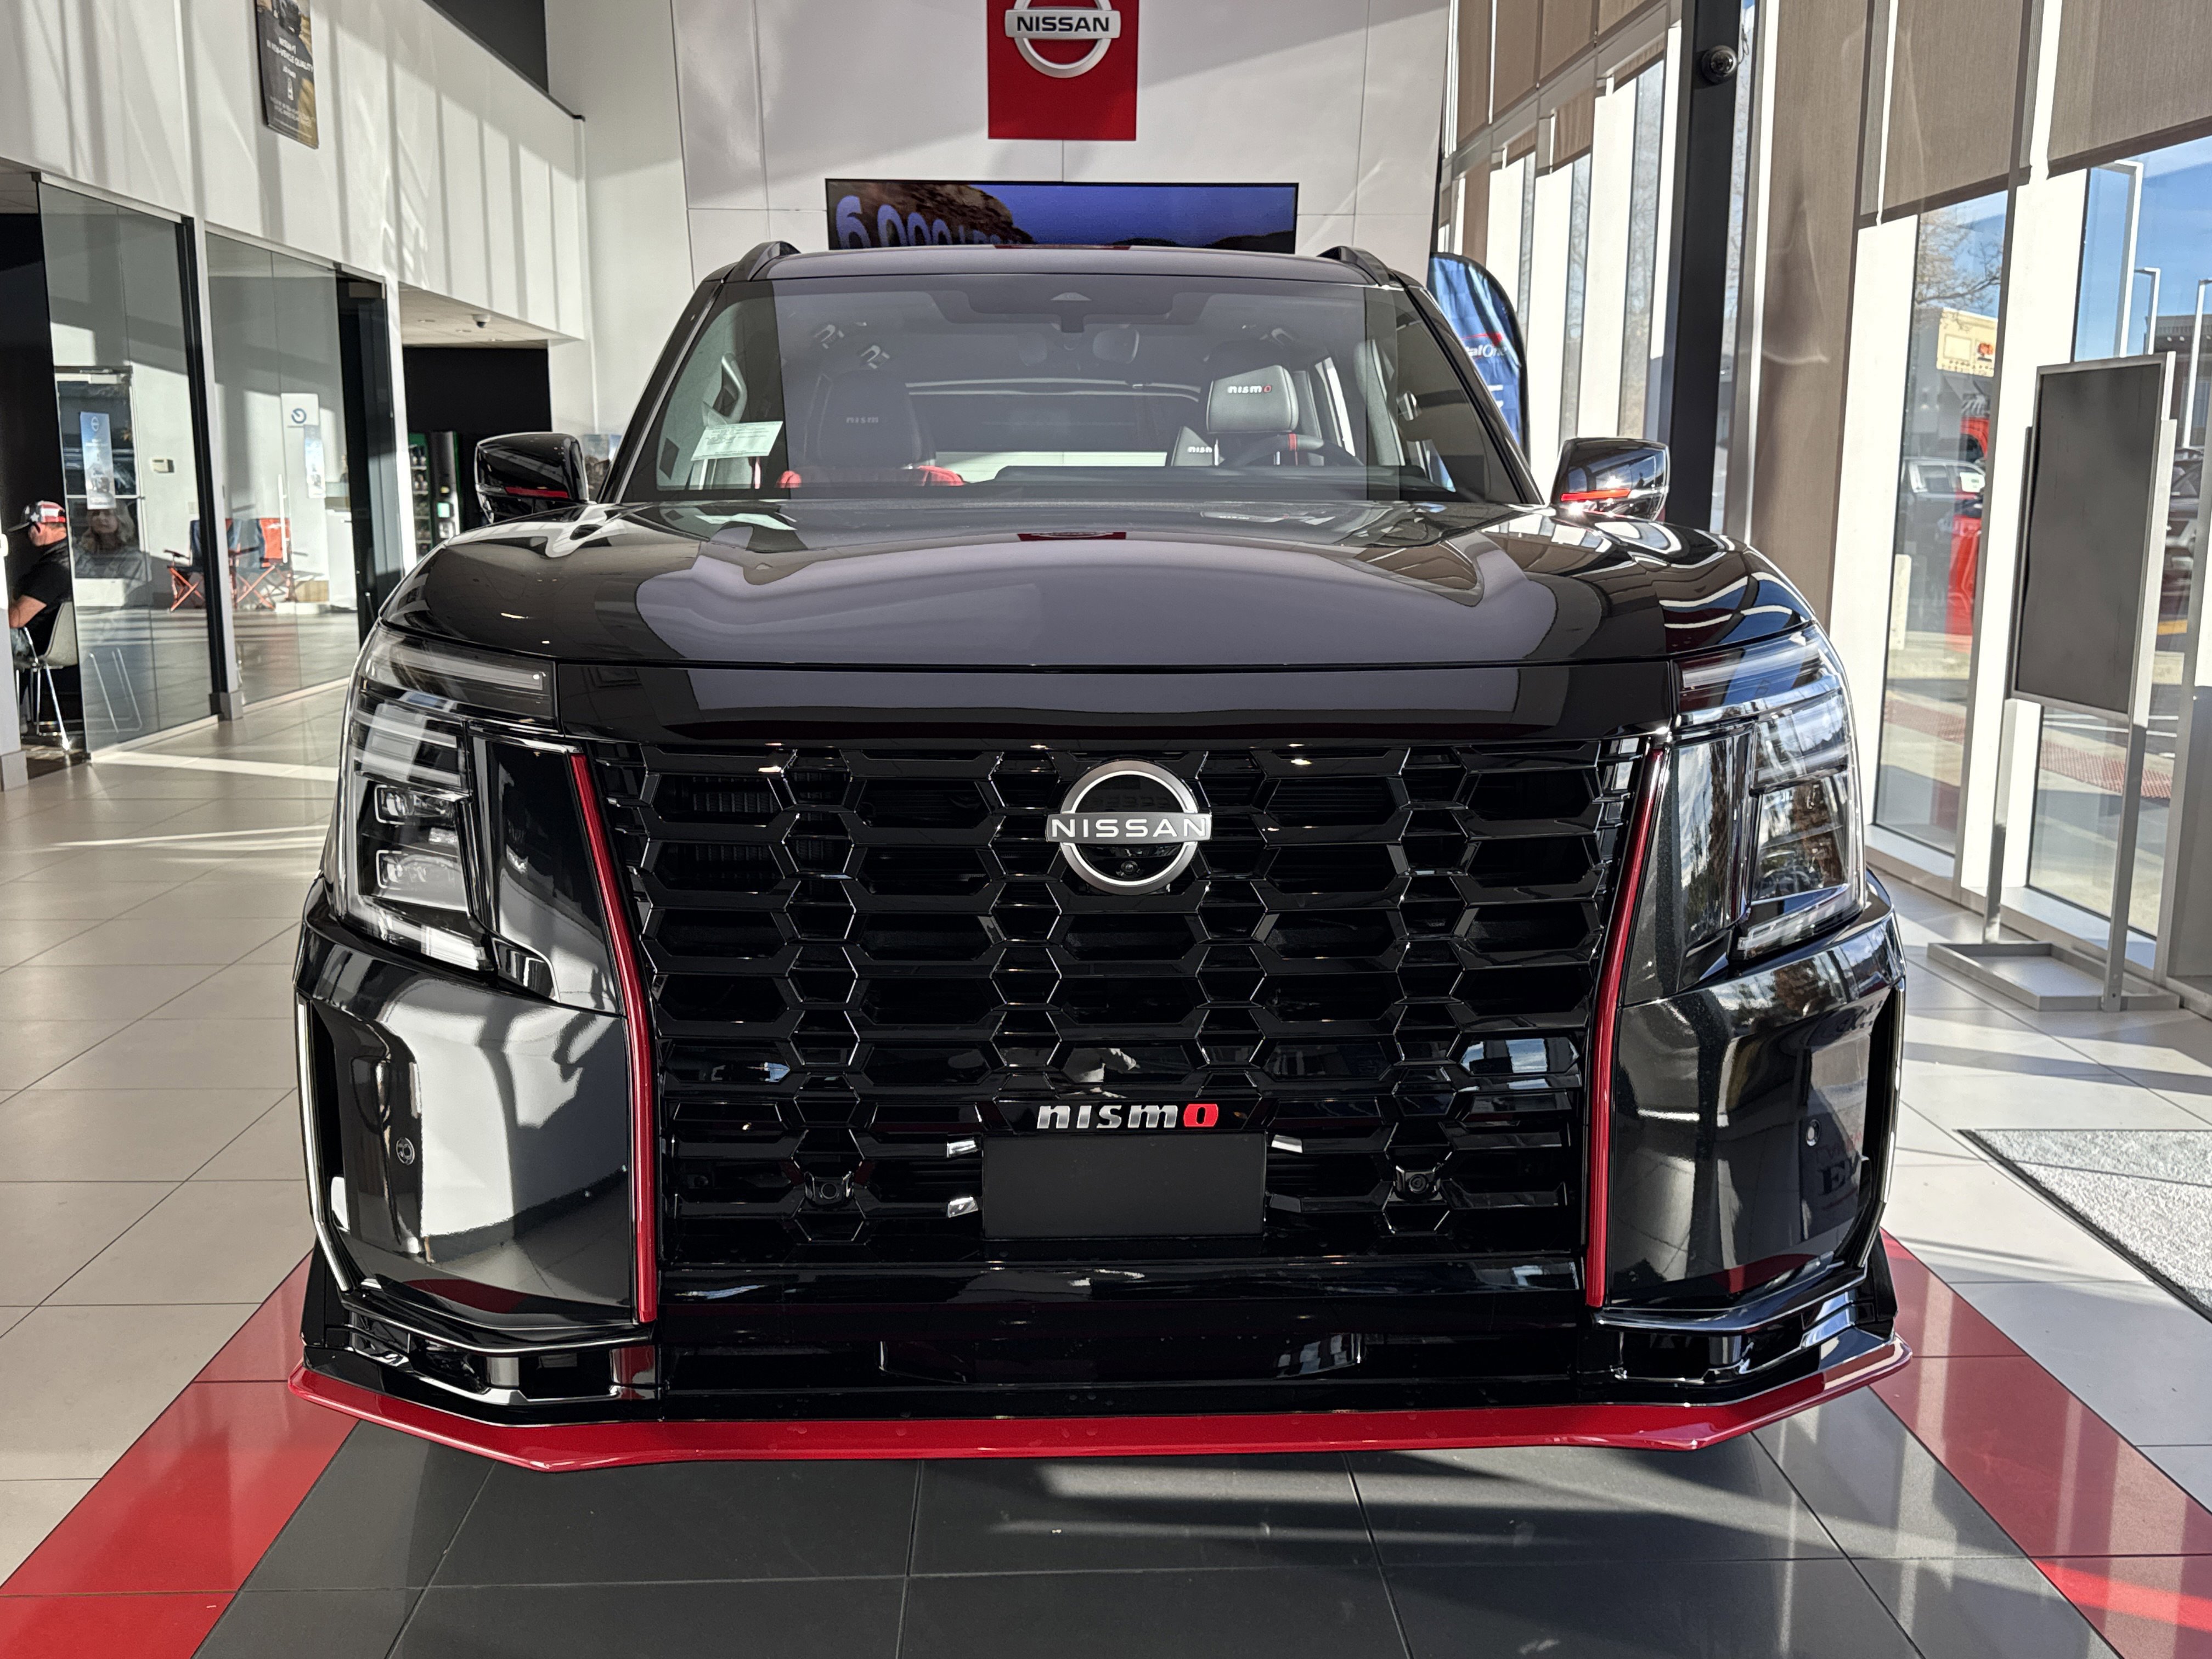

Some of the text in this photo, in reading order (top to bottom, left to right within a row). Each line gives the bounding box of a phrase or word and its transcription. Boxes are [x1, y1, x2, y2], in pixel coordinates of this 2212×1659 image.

[1017, 16, 1109, 32] NISSAN
[1228, 385, 1272, 393] nismo
[1051, 819, 1206, 838] NISSAN
[1036, 1104, 1219, 1130] nismo
